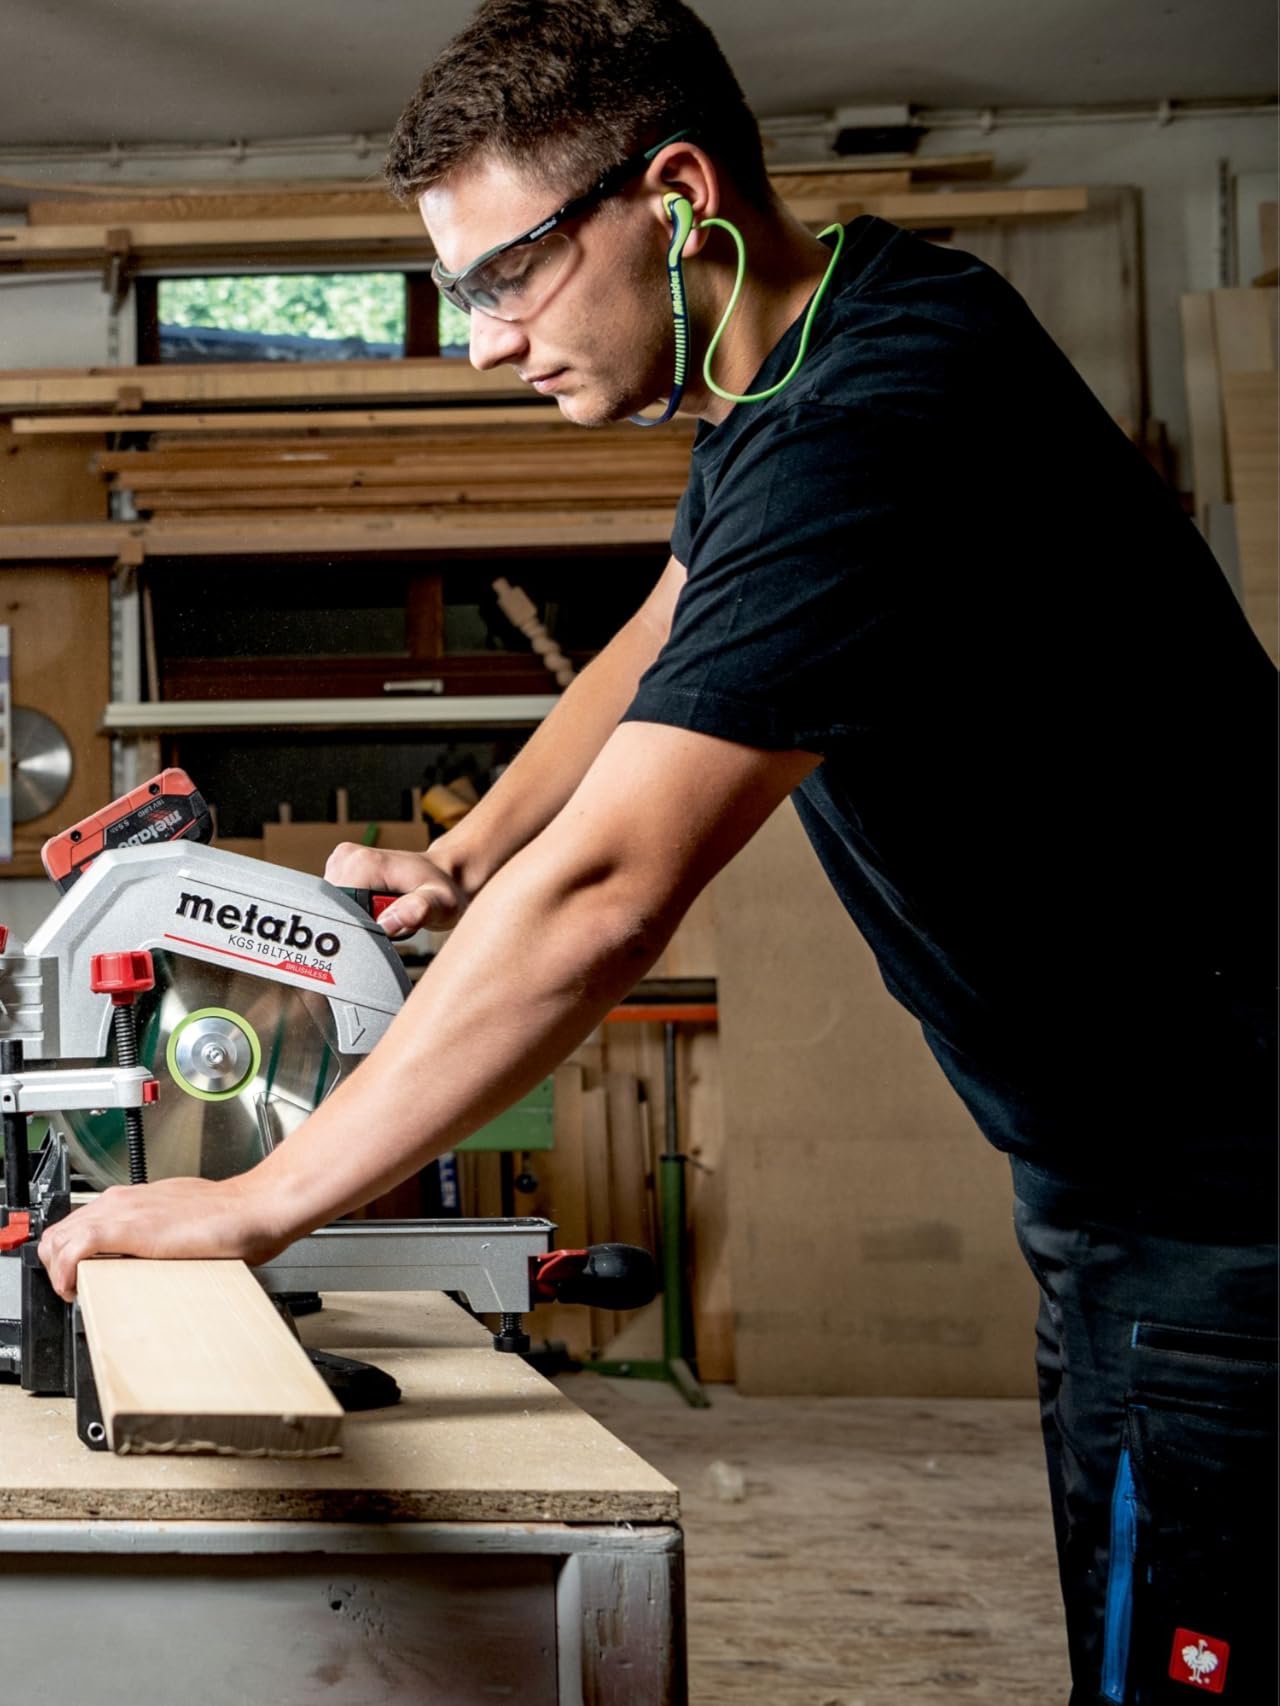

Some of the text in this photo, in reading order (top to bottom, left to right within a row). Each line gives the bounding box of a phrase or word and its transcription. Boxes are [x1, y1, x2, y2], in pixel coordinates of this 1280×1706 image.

[175, 891, 341, 957] metabo
[228, 934, 332, 972] KGS 18 LTX BL 254
[285, 963, 328, 980] BRUSHLESS
